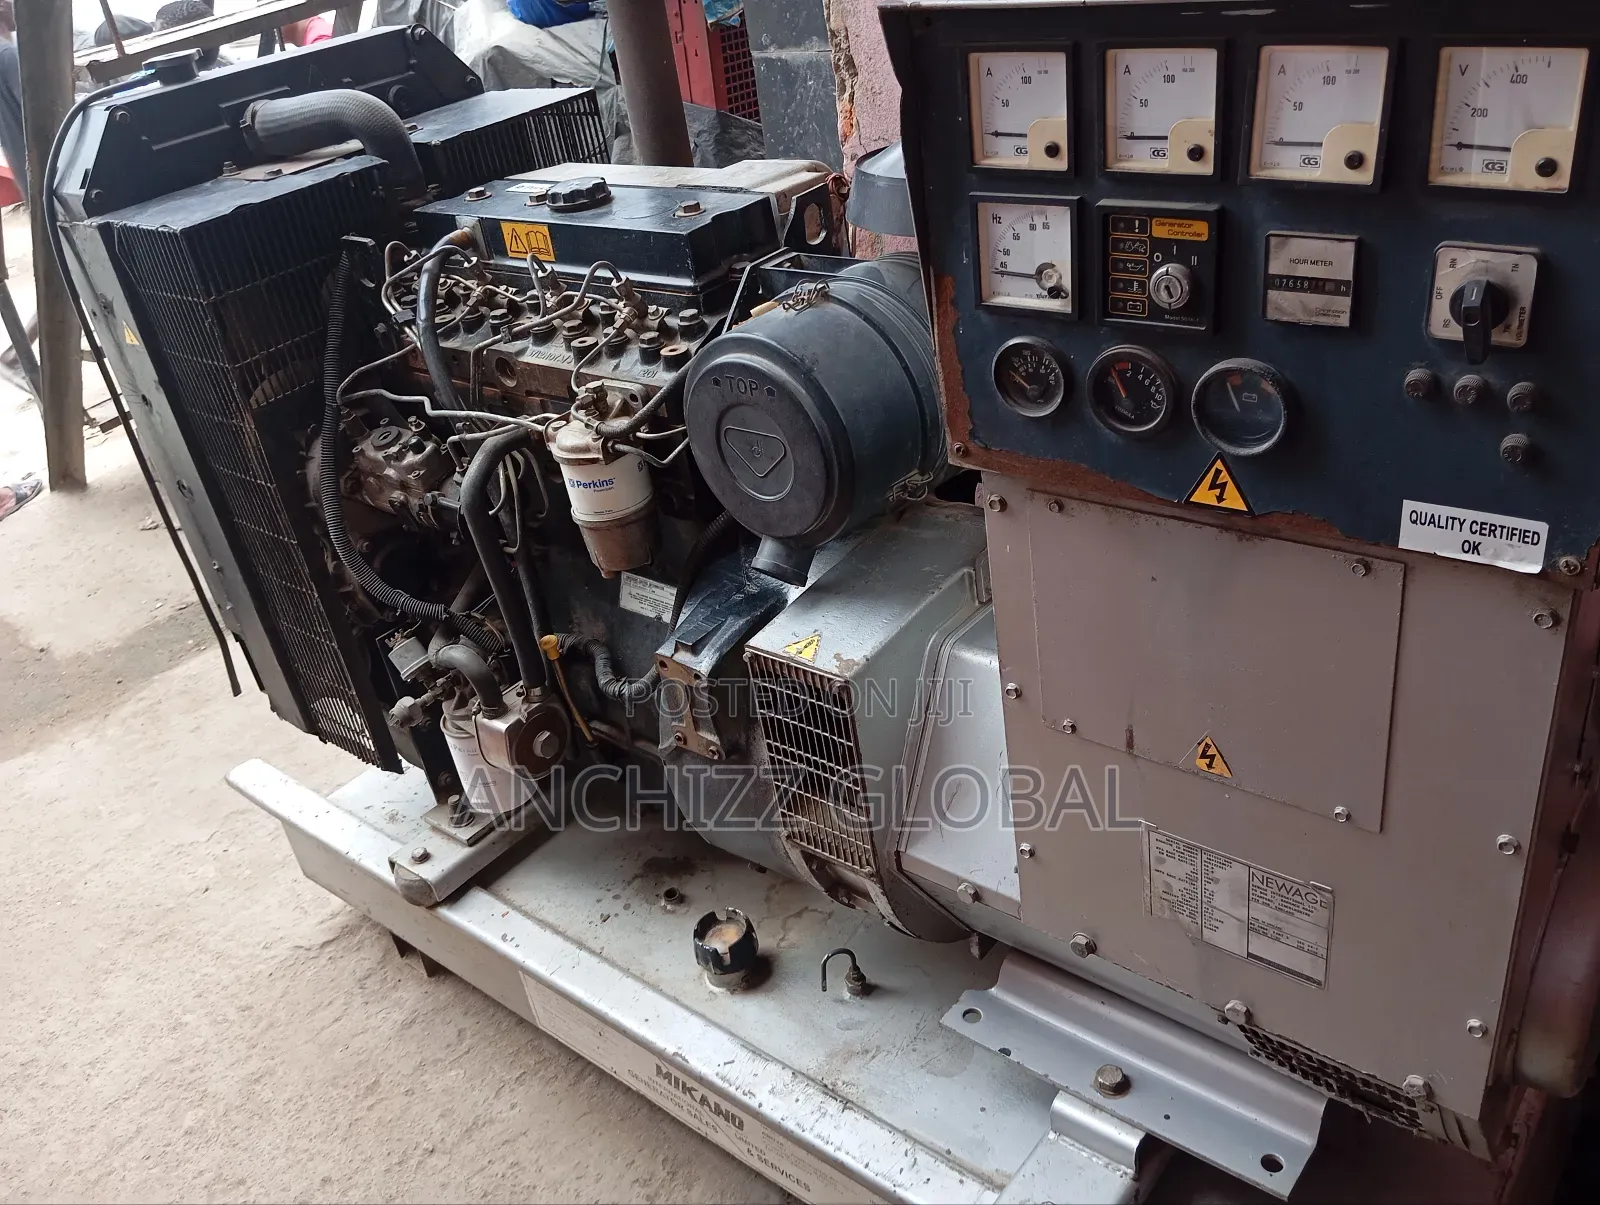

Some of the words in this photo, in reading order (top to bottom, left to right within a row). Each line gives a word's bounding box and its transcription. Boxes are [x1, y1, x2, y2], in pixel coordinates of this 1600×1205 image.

[986, 67, 992, 77] A
[1123, 65, 1131, 75] A
[1278, 64, 1286, 75] A
[1459, 64, 1469, 76] V
[1021, 76, 1031, 84] 100
[1163, 74, 1175, 83] 100
[1322, 76, 1336, 85] 100
[1510, 74, 1527, 84] 400
[1140, 99, 1148, 107] 50
[1293, 102, 1303, 111] 50
[1471, 108, 1488, 118] 200
[992, 213, 1002, 224] Hz
[1156, 220, 1193, 228] Generator
[1168, 229, 1204, 237] Controller
[1449, 259, 1457, 268] RN
[1511, 264, 1519, 272] TN
[1443, 319, 1450, 328] RS
[725, 375, 758, 396] TOP
[576, 478, 614, 489] Perkins
[1409, 510, 1466, 532] QUALITY
[1469, 520, 1540, 546] CERTIFIED
[1462, 540, 1482, 555] OK
[1251, 870, 1327, 909] NEWAGE
[656, 1063, 744, 1131] MIKANO
[628, 1069, 684, 1112] GENERATOR
[687, 1108, 718, 1133] SALES
[748, 1148, 754, 1158] &
[758, 1154, 811, 1192] SERVICES
